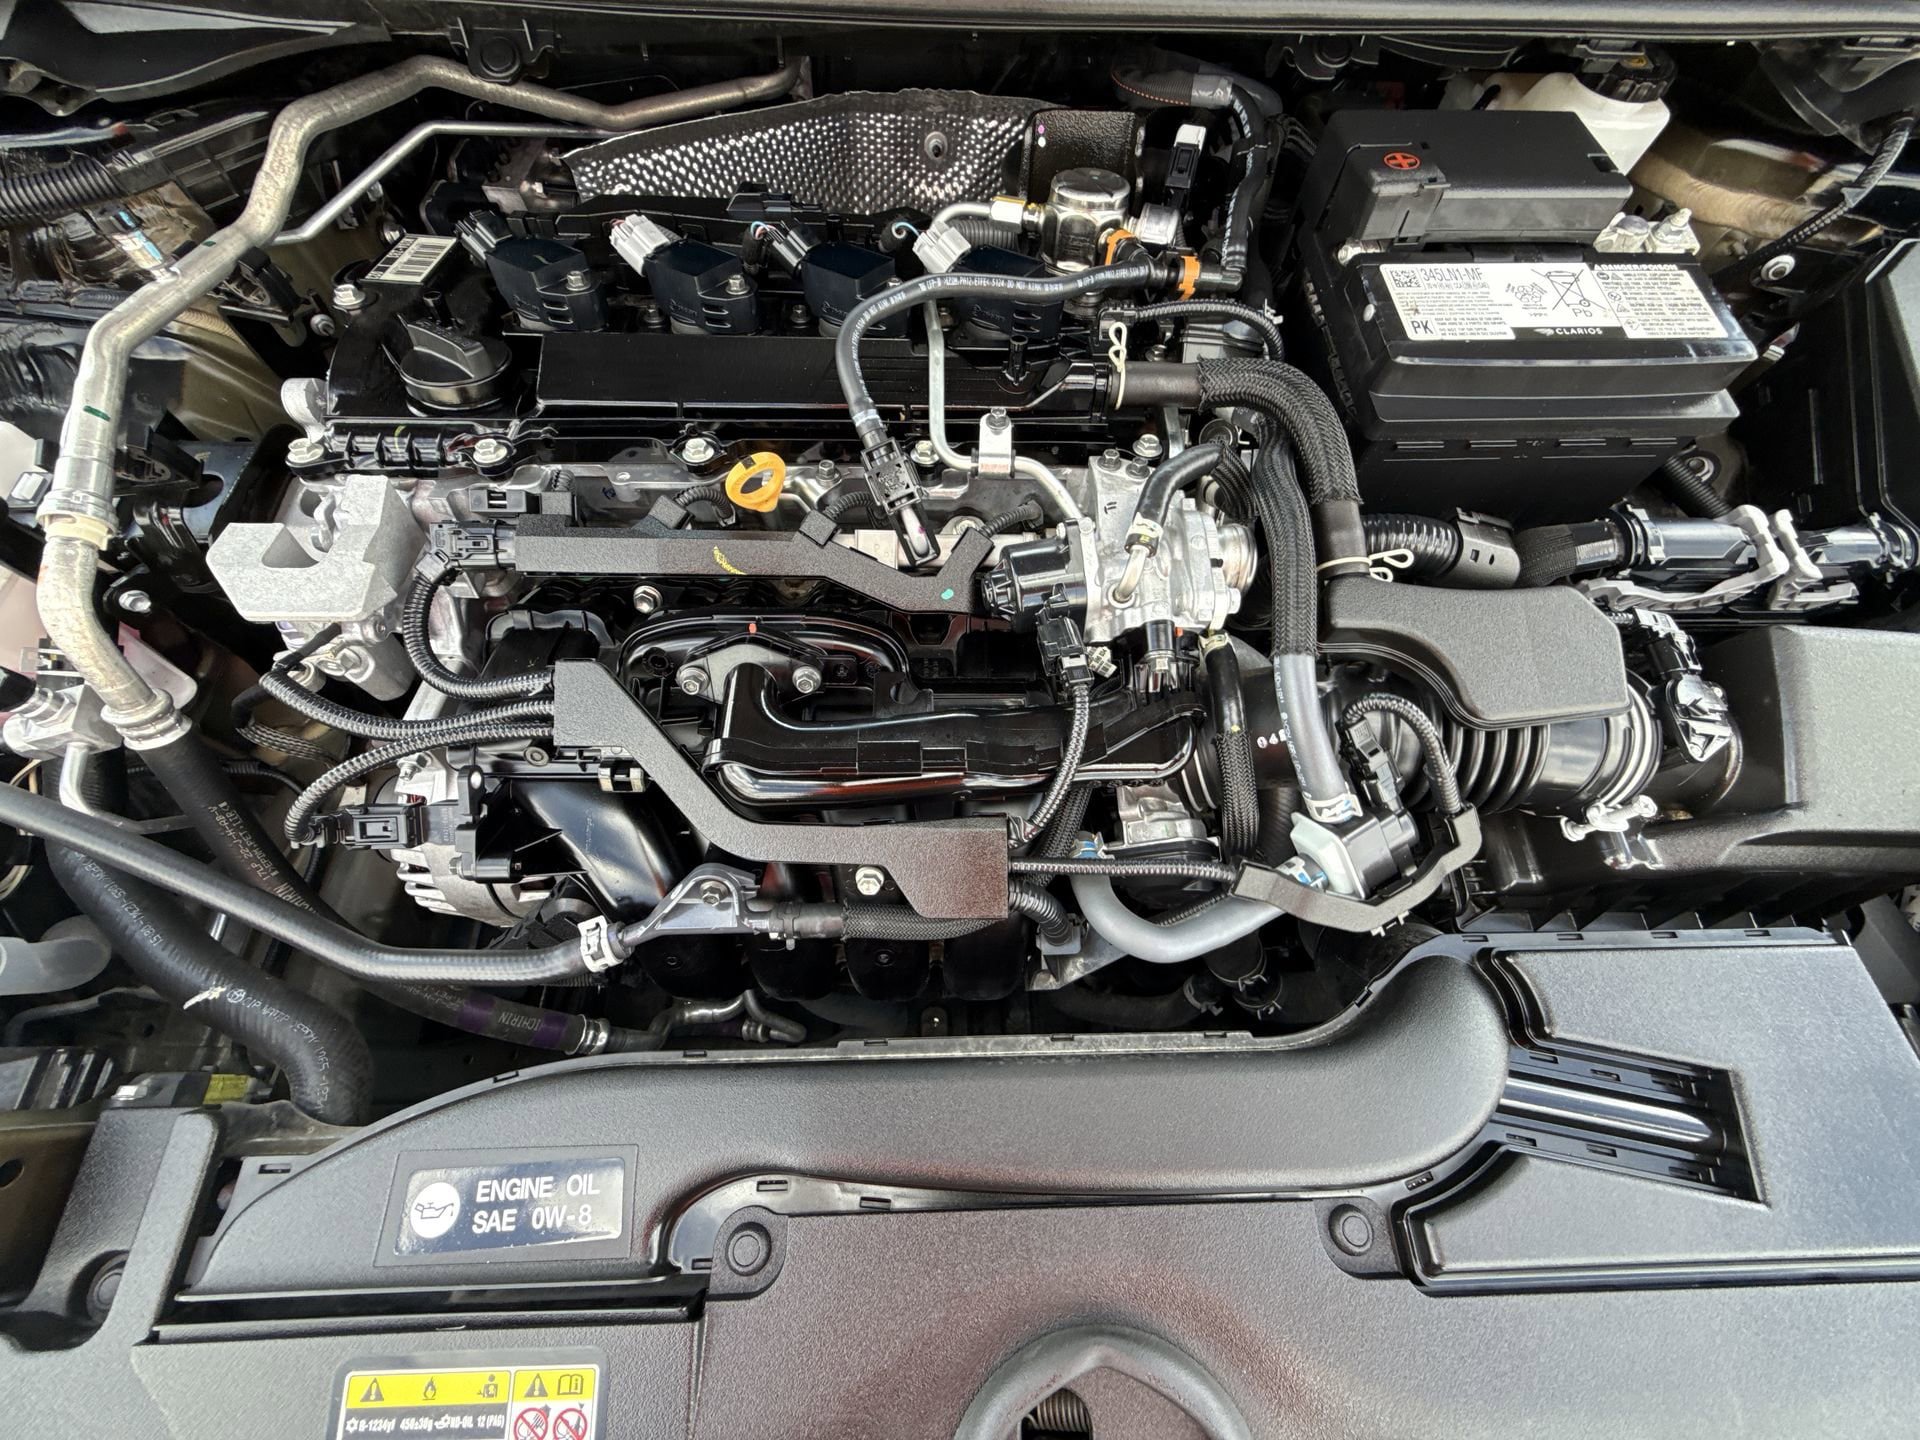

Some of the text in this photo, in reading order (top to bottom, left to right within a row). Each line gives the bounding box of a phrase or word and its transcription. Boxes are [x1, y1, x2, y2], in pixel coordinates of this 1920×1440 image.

[1420, 267, 1484, 282] 345LN1-MF
[1572, 307, 1593, 318] Pb
[1410, 320, 1433, 335] PK
[1555, 327, 1604, 336] CLARIOS
[475, 1174, 601, 1203] ENGINE OIL
[472, 1204, 592, 1235] SAE 0W-8
[477, 1415, 487, 1428] 12
